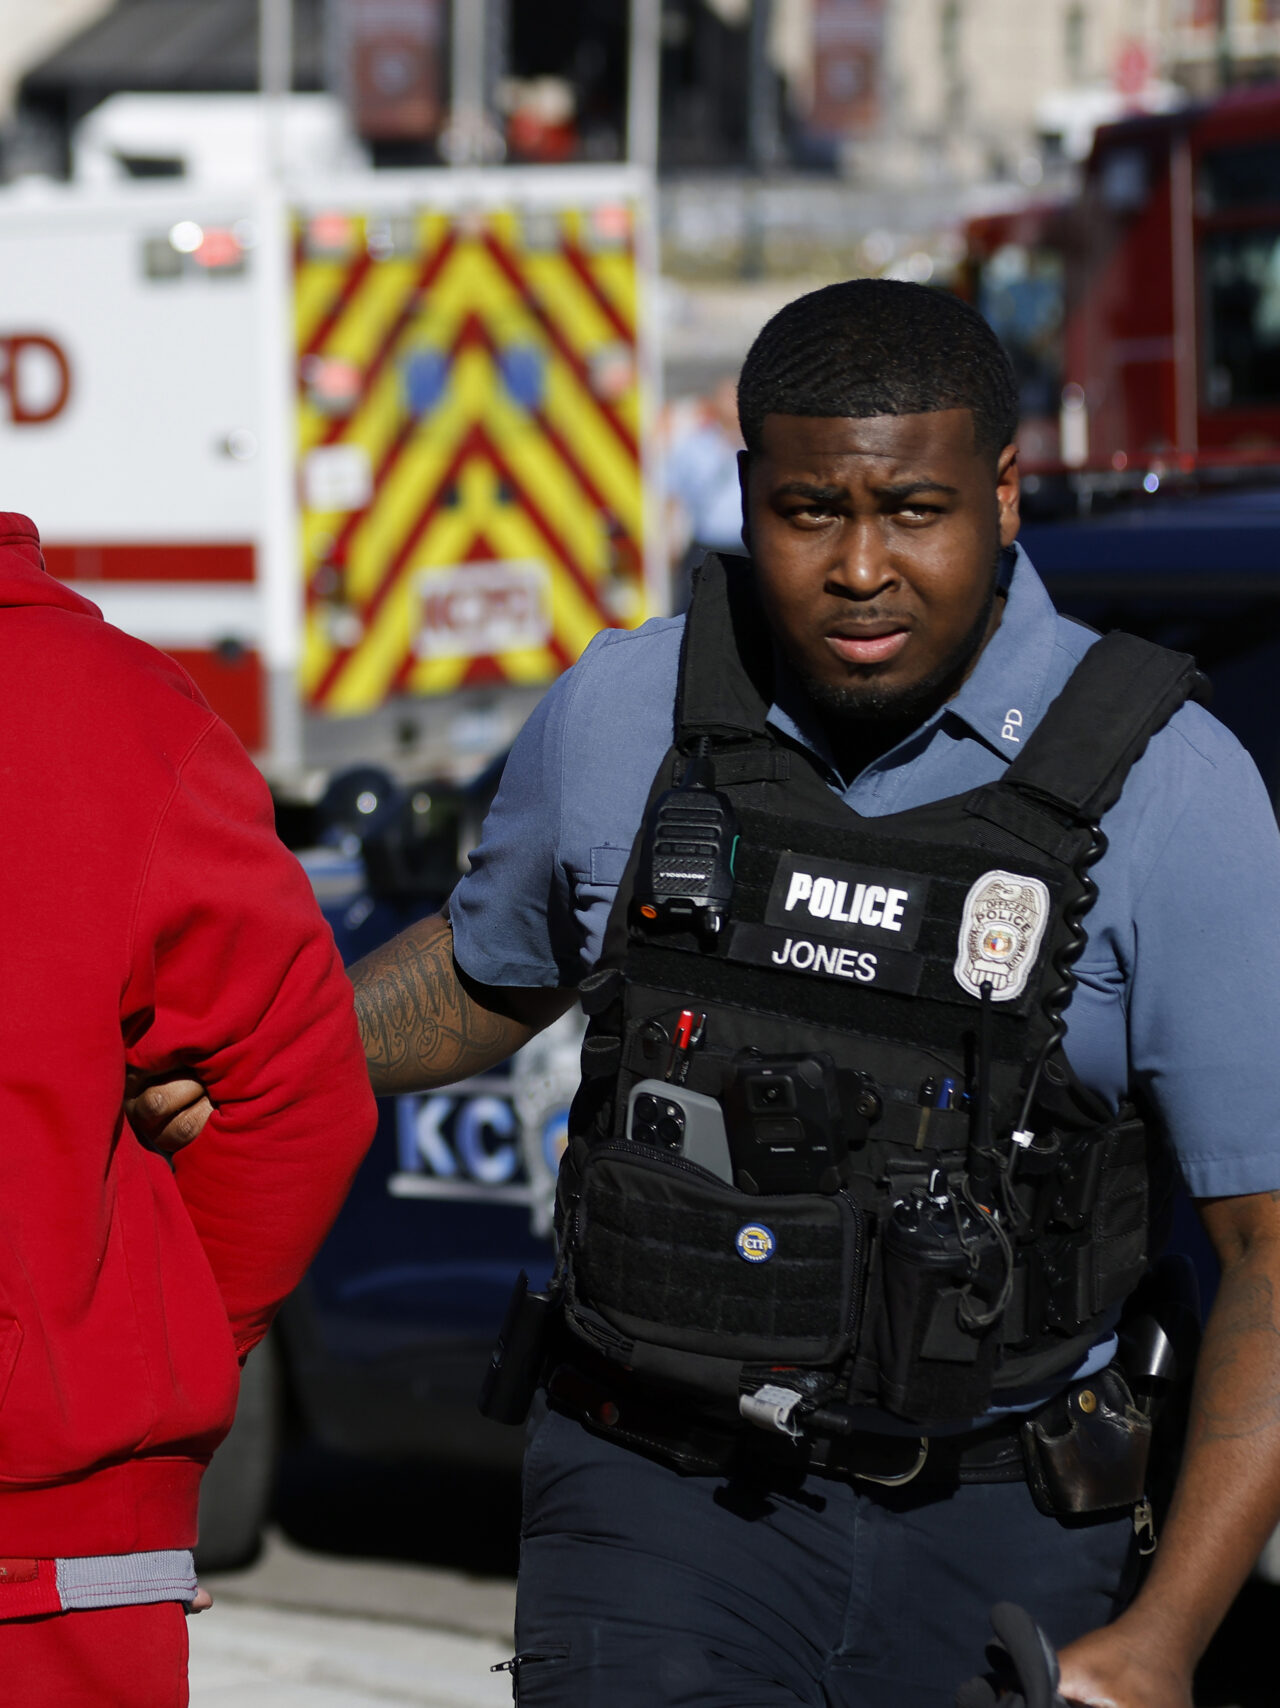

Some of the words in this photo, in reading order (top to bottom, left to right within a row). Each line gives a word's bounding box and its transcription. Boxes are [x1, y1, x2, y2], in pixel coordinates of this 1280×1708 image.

[1001, 708, 1023, 743] PD
[784, 871, 909, 932] POLICE
[975, 910, 1032, 934] POLICE
[771, 938, 878, 982] JONES
[743, 1238, 767, 1250] CIT
